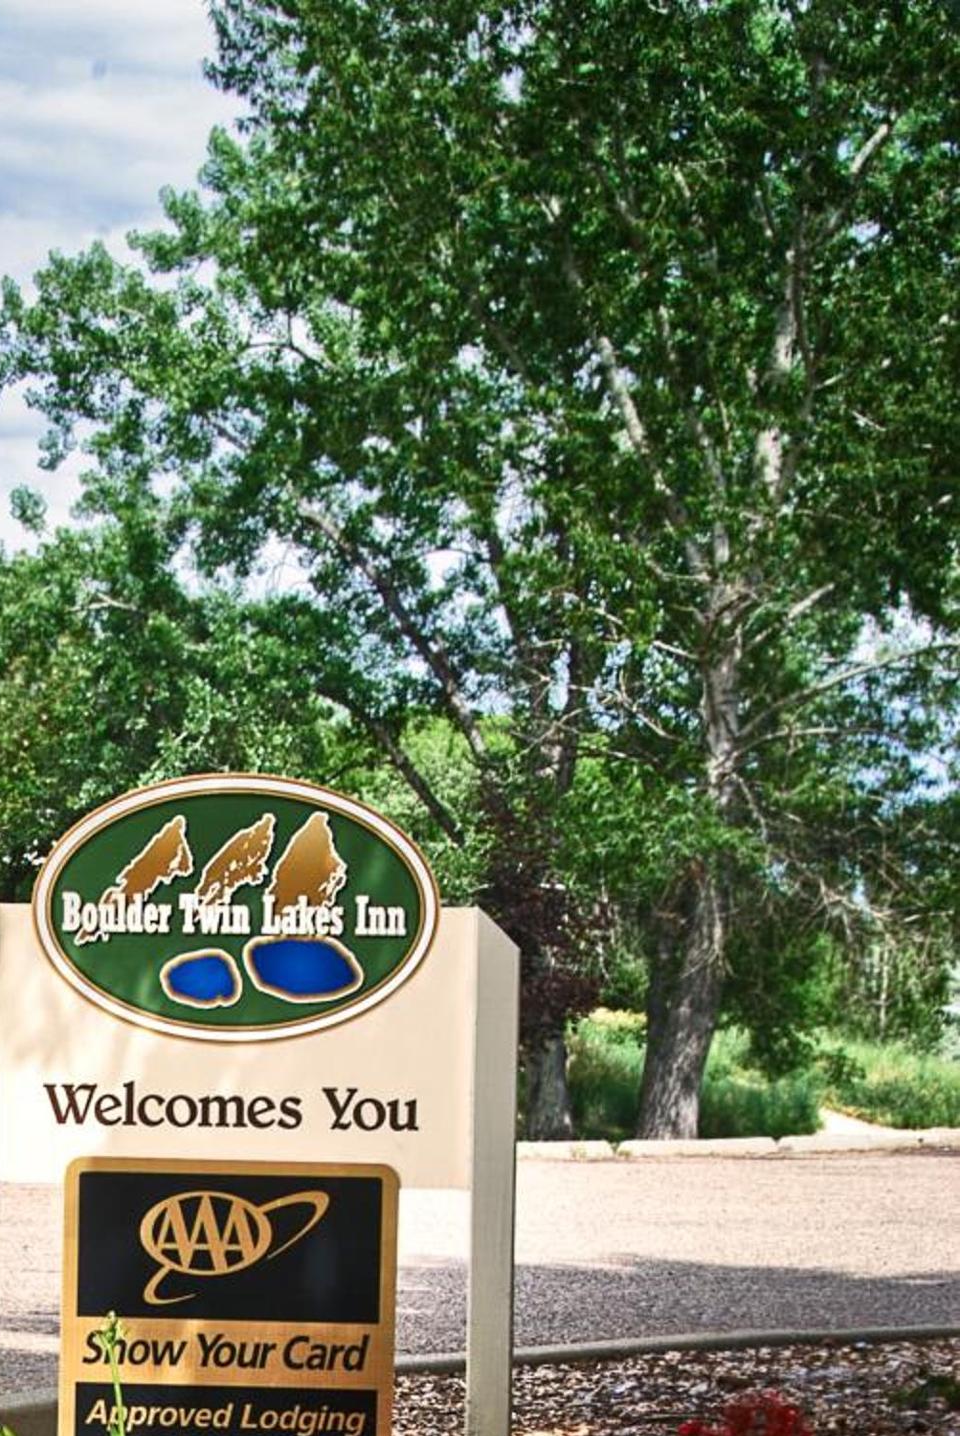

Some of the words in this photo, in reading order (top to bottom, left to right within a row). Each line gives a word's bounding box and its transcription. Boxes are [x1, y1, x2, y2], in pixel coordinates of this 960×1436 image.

[61, 890, 172, 933] Boulder
[178, 892, 251, 935] Twin
[260, 894, 345, 936] Lakes
[354, 895, 407, 937] Inn
[43, 1081, 303, 1130] Welcomes
[321, 1087, 419, 1132] You
[153, 1193, 260, 1271] AAA
[197, 1332, 276, 1370] Your
[282, 1334, 369, 1372] Card
[85, 1399, 232, 1433] Approved
